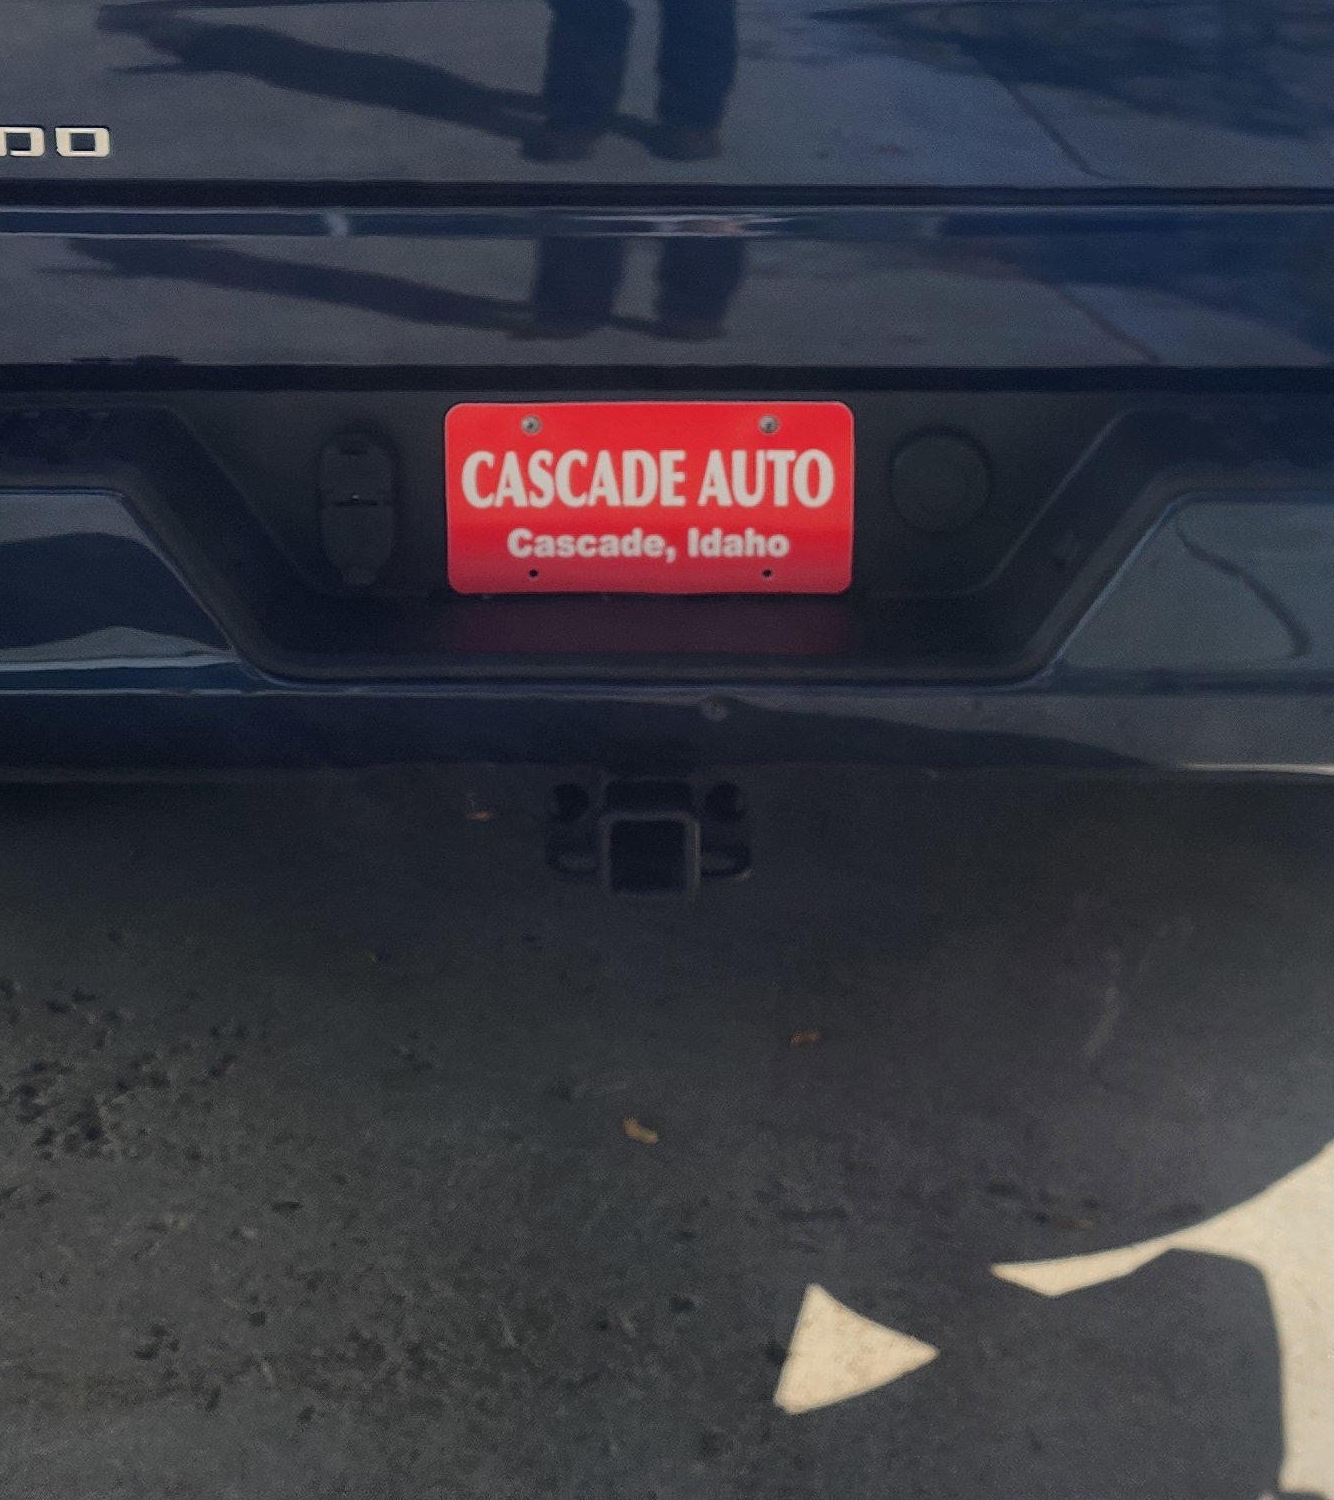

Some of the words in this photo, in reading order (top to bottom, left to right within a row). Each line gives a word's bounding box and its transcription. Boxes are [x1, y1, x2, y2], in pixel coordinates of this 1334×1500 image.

[462, 449, 686, 508] CASCADE
[698, 449, 835, 508] AUTO
[507, 527, 676, 562] Cascade,
[687, 527, 790, 560] Idaho
